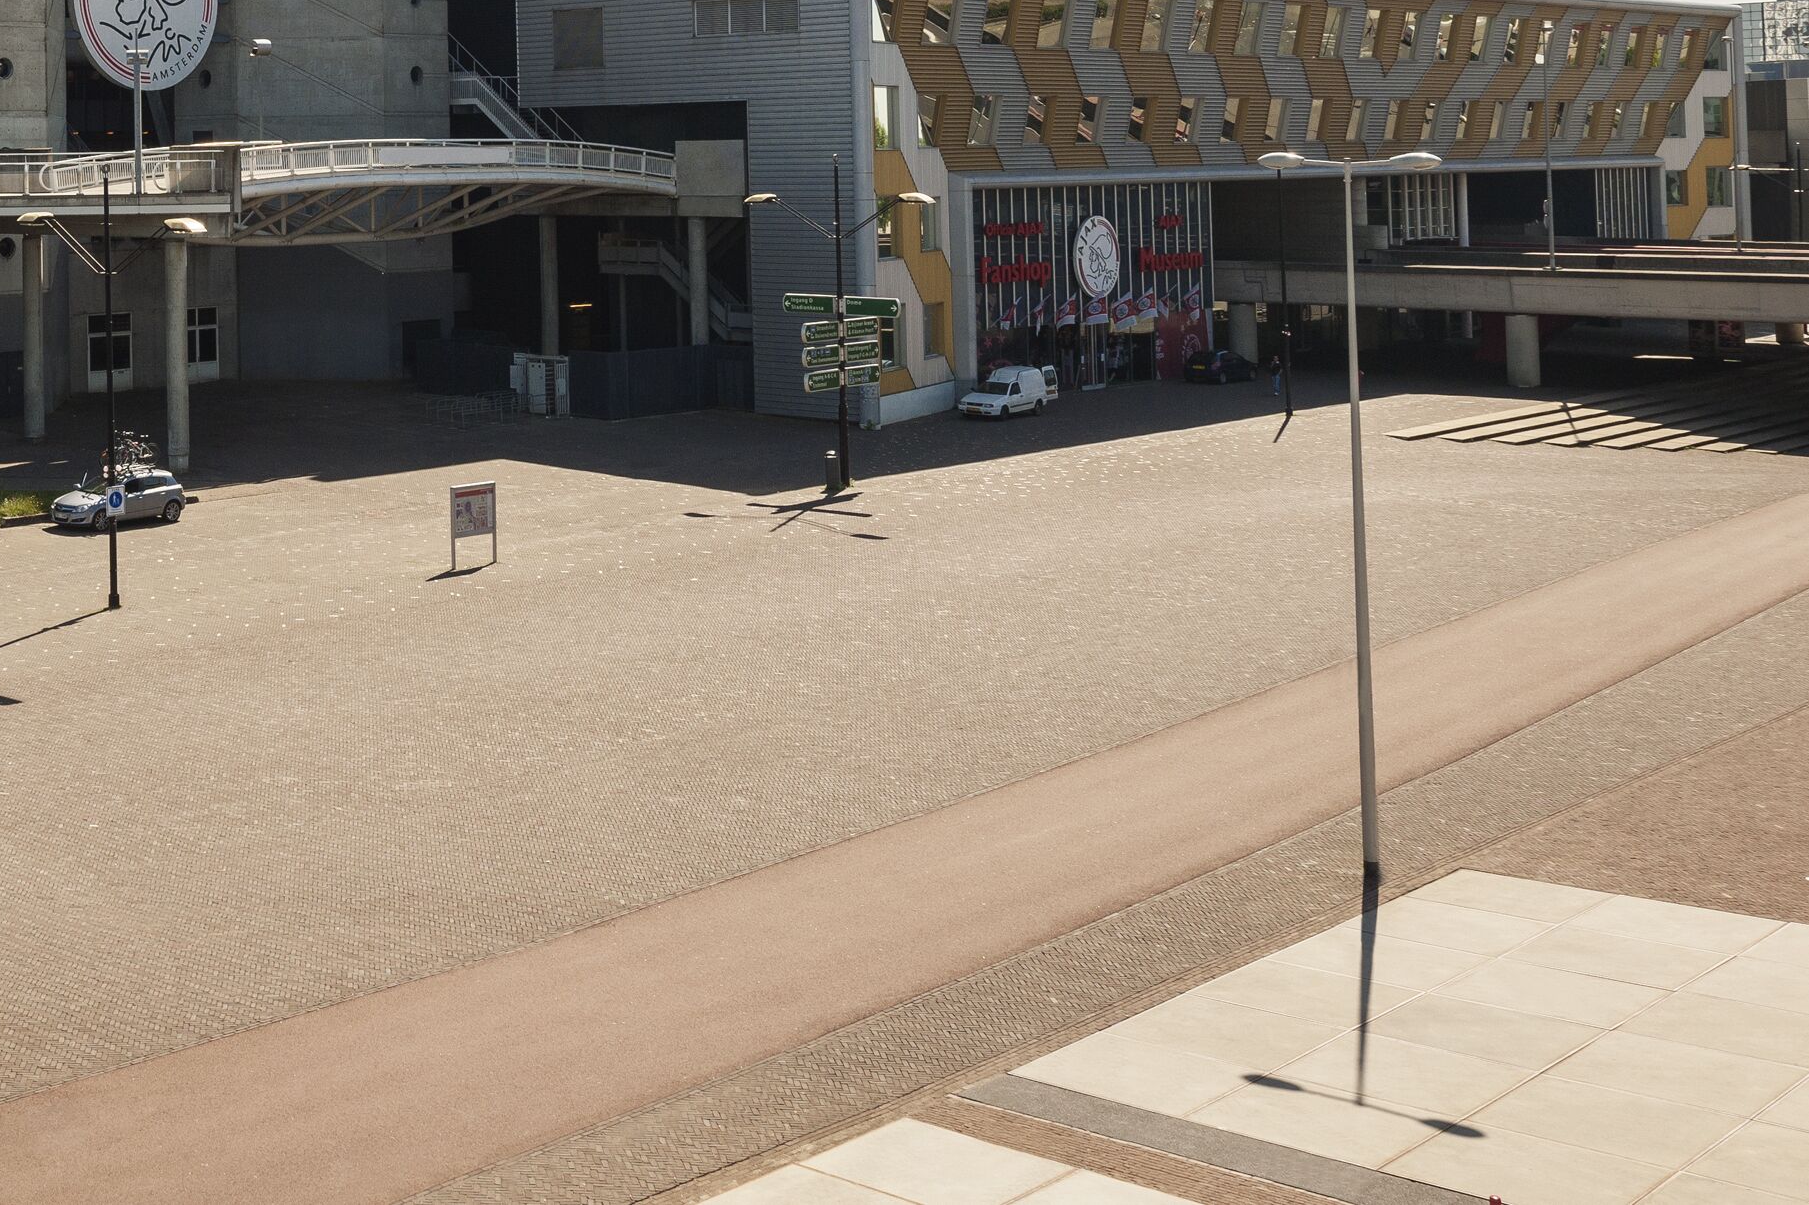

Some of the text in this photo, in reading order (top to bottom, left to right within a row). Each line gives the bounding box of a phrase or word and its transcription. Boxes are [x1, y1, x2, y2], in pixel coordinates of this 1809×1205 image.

[152, 23, 208, 82] AMSTERDAM
[1017, 221, 1044, 237] AJAX
[1078, 218, 1097, 256] AJAX
[979, 253, 1052, 288] Fanshop
[1138, 246, 1204, 273] Museum
